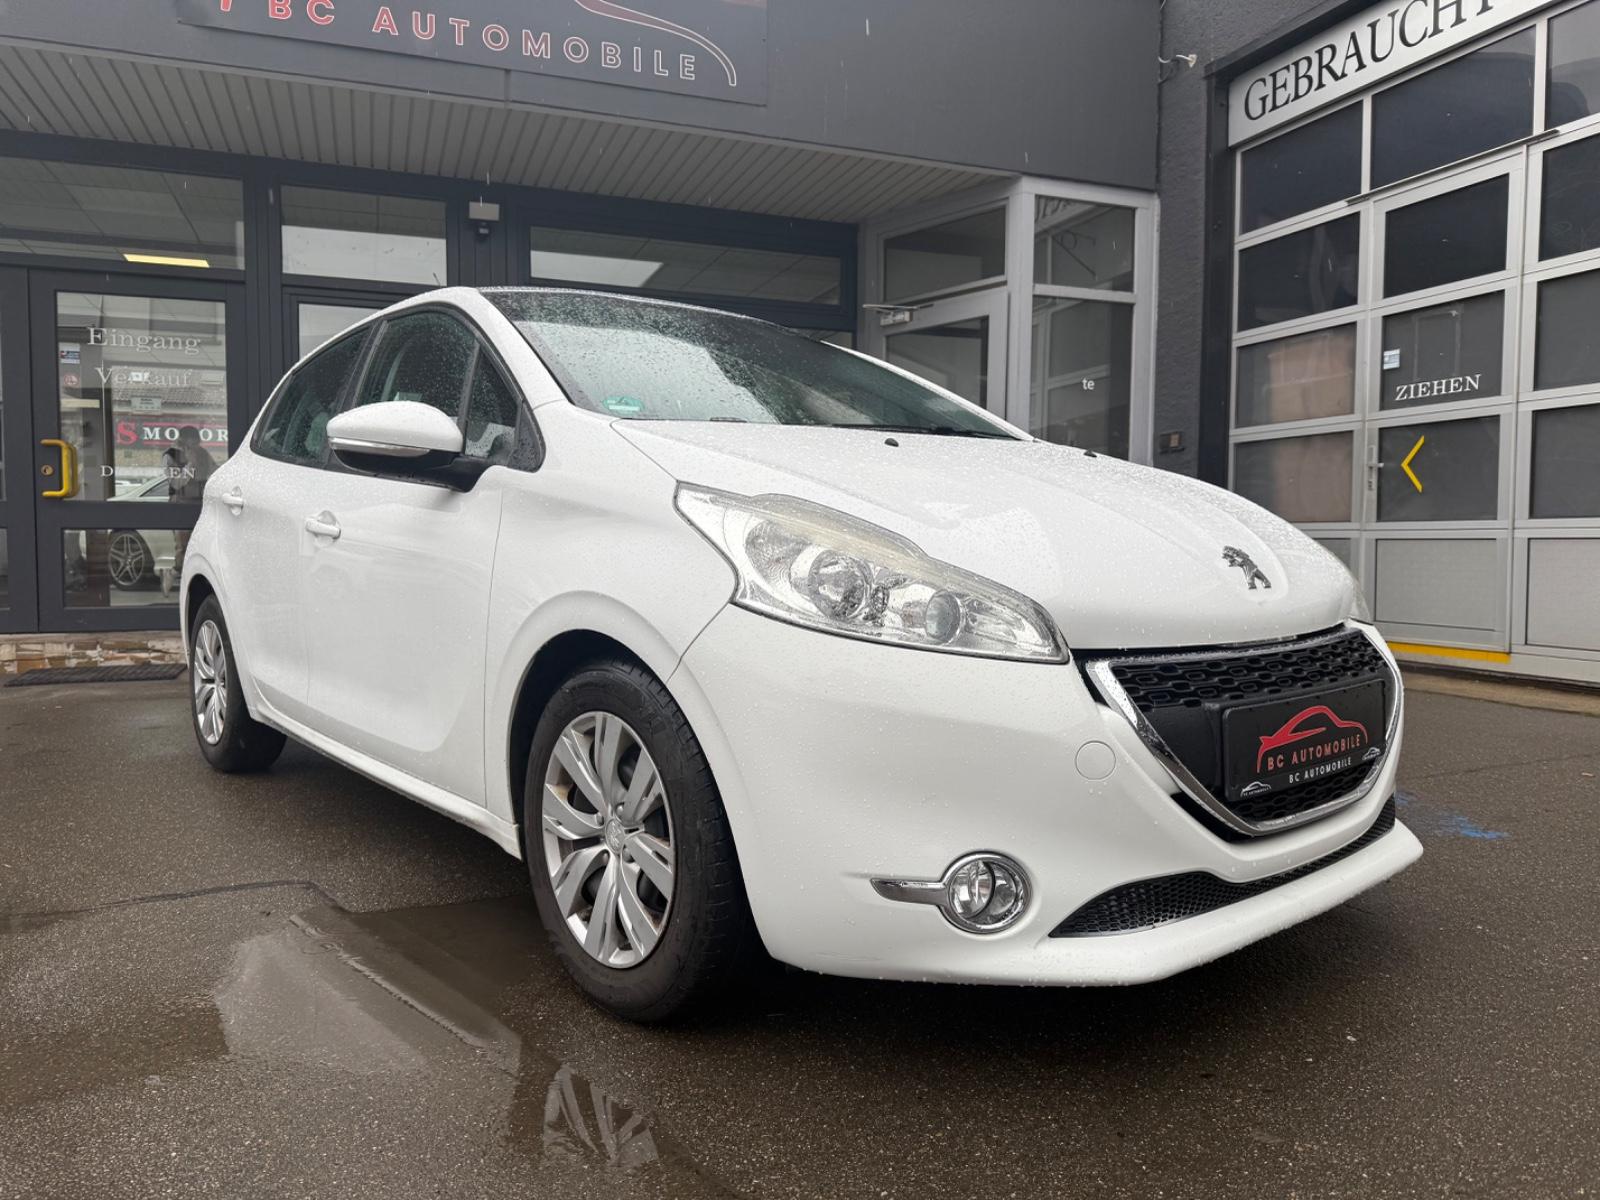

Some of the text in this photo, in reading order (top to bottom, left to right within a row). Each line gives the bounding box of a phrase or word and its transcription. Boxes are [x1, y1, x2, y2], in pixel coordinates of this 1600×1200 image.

[268, 0, 696, 81] BC AUTOMOBILE
[87, 326, 201, 354] Eingang
[1082, 378, 1095, 390] te
[1395, 374, 1482, 400] ZIEHEN
[143, 427, 228, 442] MOOR
[1267, 754, 1284, 771] BC
[1291, 734, 1360, 765] AUTOMOBILE
[1289, 756, 1352, 784] BC AUTOMOBILE
